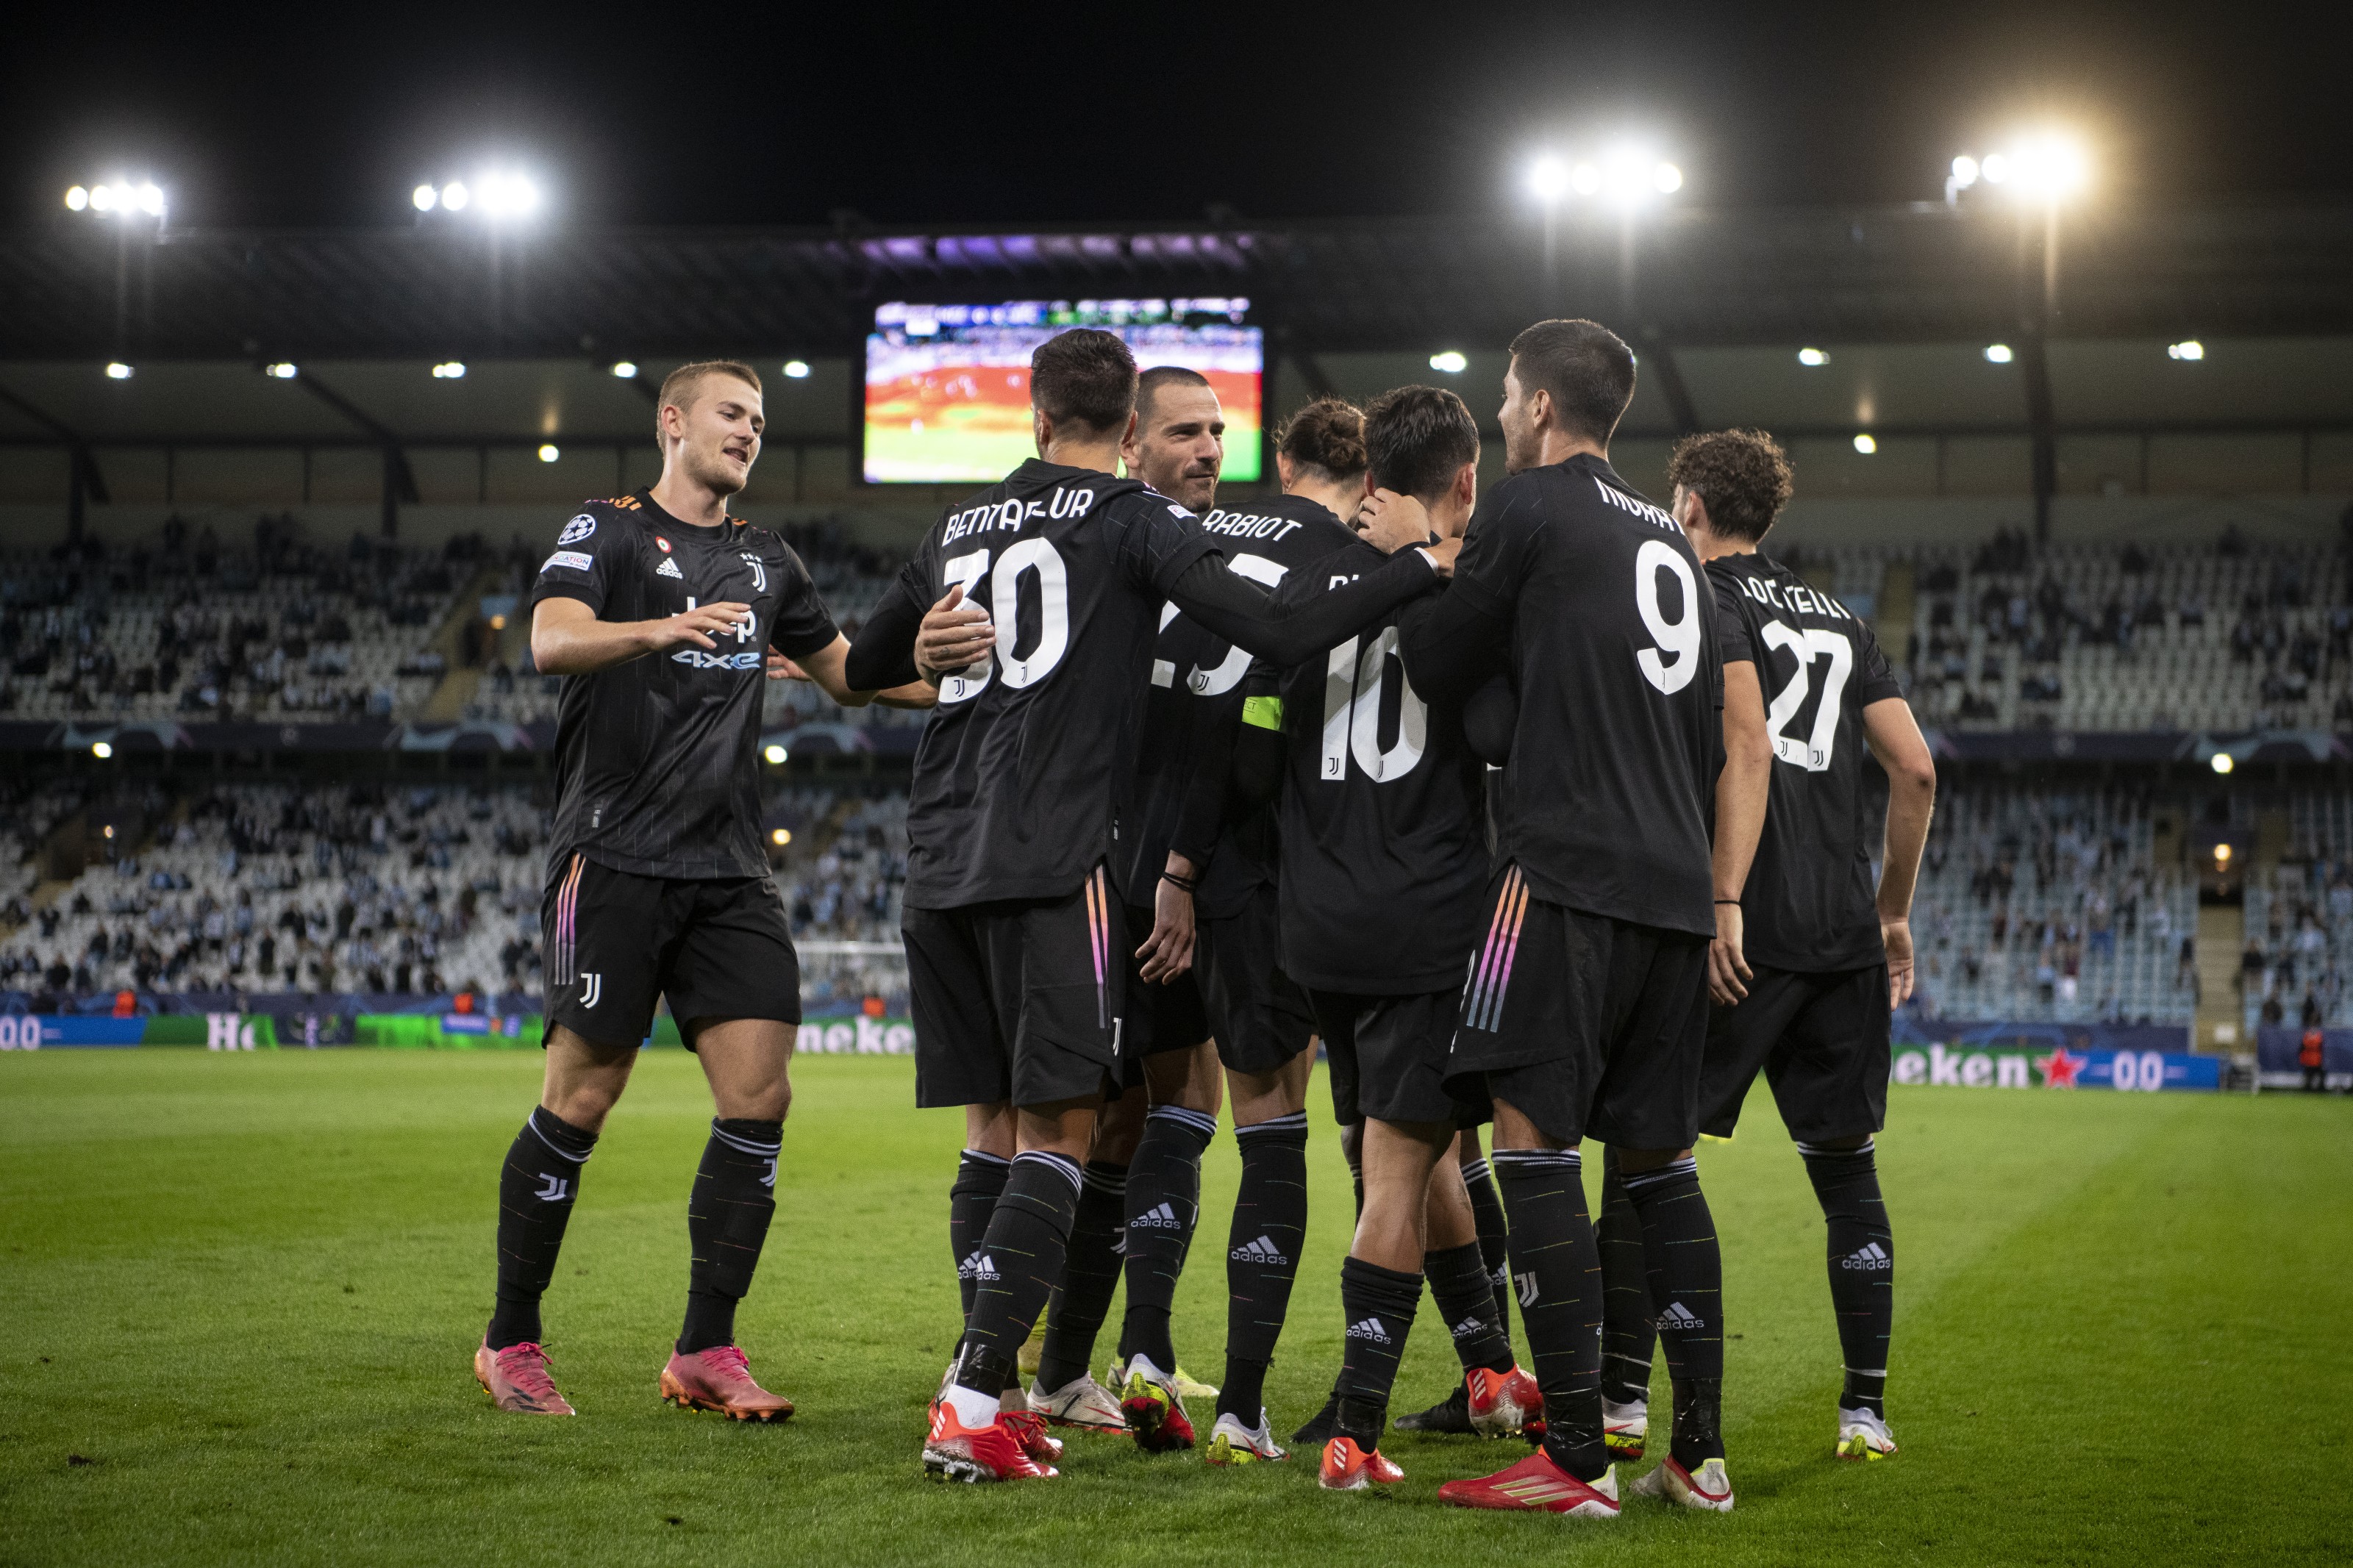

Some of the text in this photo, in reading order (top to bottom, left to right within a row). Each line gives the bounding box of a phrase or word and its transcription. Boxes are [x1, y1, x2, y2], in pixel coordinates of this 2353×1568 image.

[1202, 509, 1303, 542] RABIOT
[656, 566, 683, 579] adidas
[1732, 575, 1852, 620] LOCTELLI
[938, 537, 1068, 704] 30
[1636, 540, 1701, 695] 9
[1321, 626, 1428, 783] 10
[1761, 620, 1852, 772] 27
[1131, 1216, 1181, 1229] adidas
[1231, 1250, 1288, 1265] adidas
[1842, 1257, 1890, 1270] adidas
[1346, 1326, 1391, 1345] adidas
[1657, 1318, 1704, 1330] adidas
